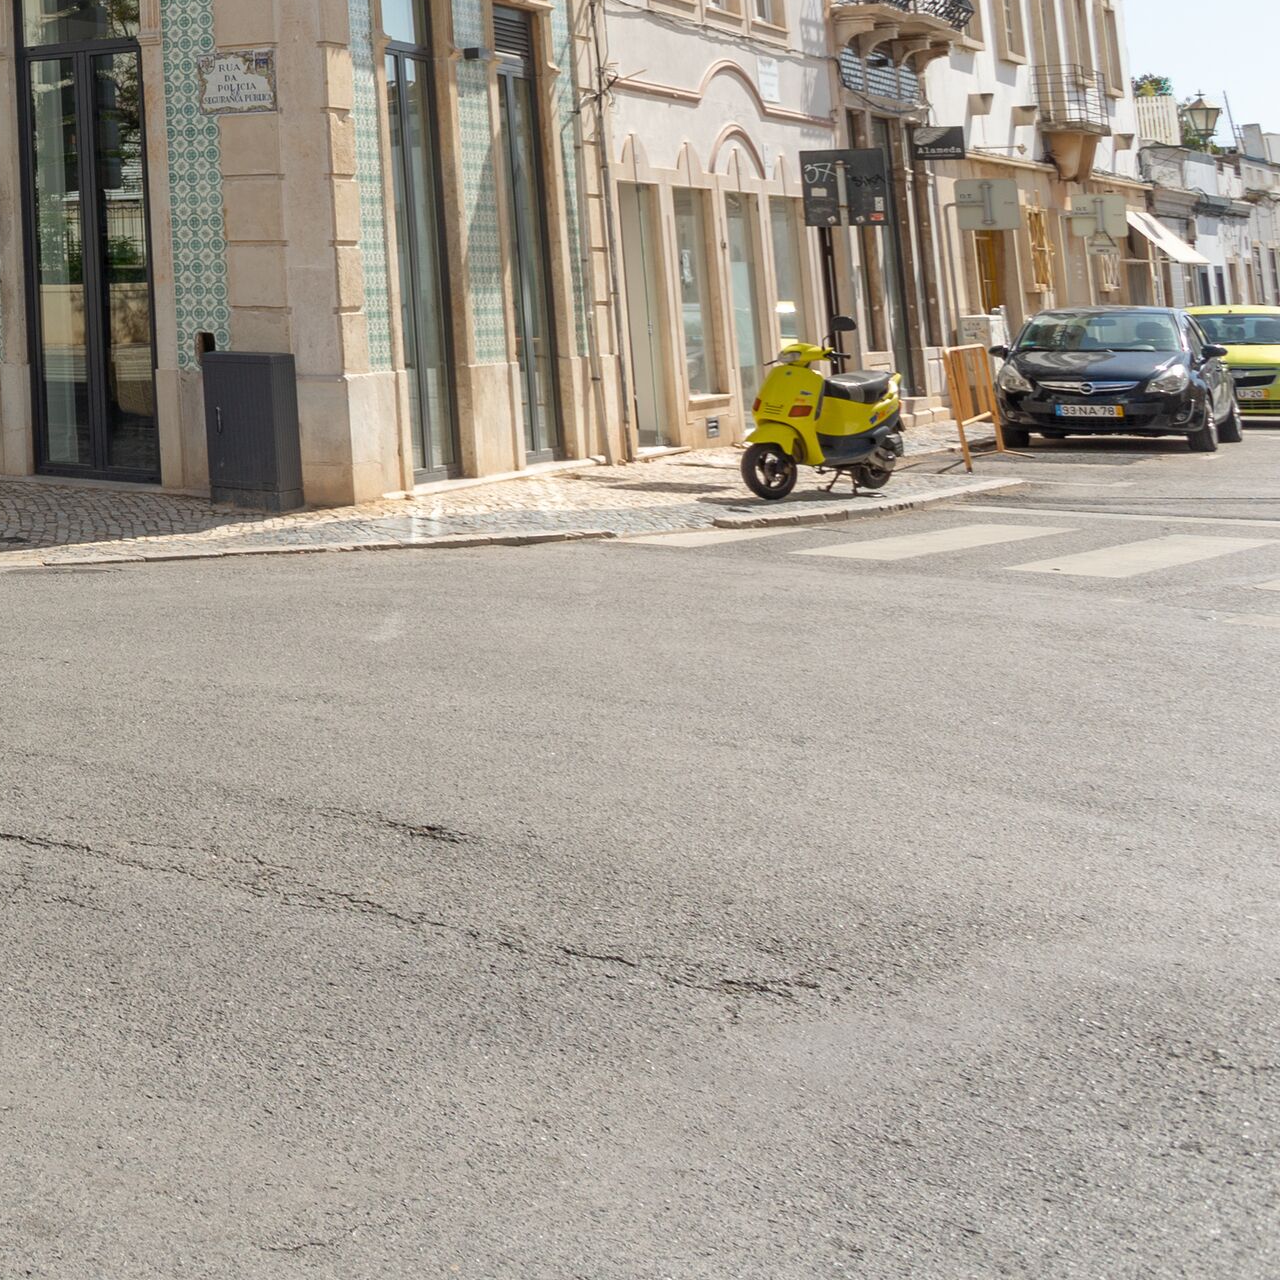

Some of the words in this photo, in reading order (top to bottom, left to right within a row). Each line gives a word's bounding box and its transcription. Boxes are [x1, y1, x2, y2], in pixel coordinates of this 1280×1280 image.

[218, 63, 241, 72] RUA
[224, 74, 238, 82] DA
[917, 145, 962, 154] Alameda
